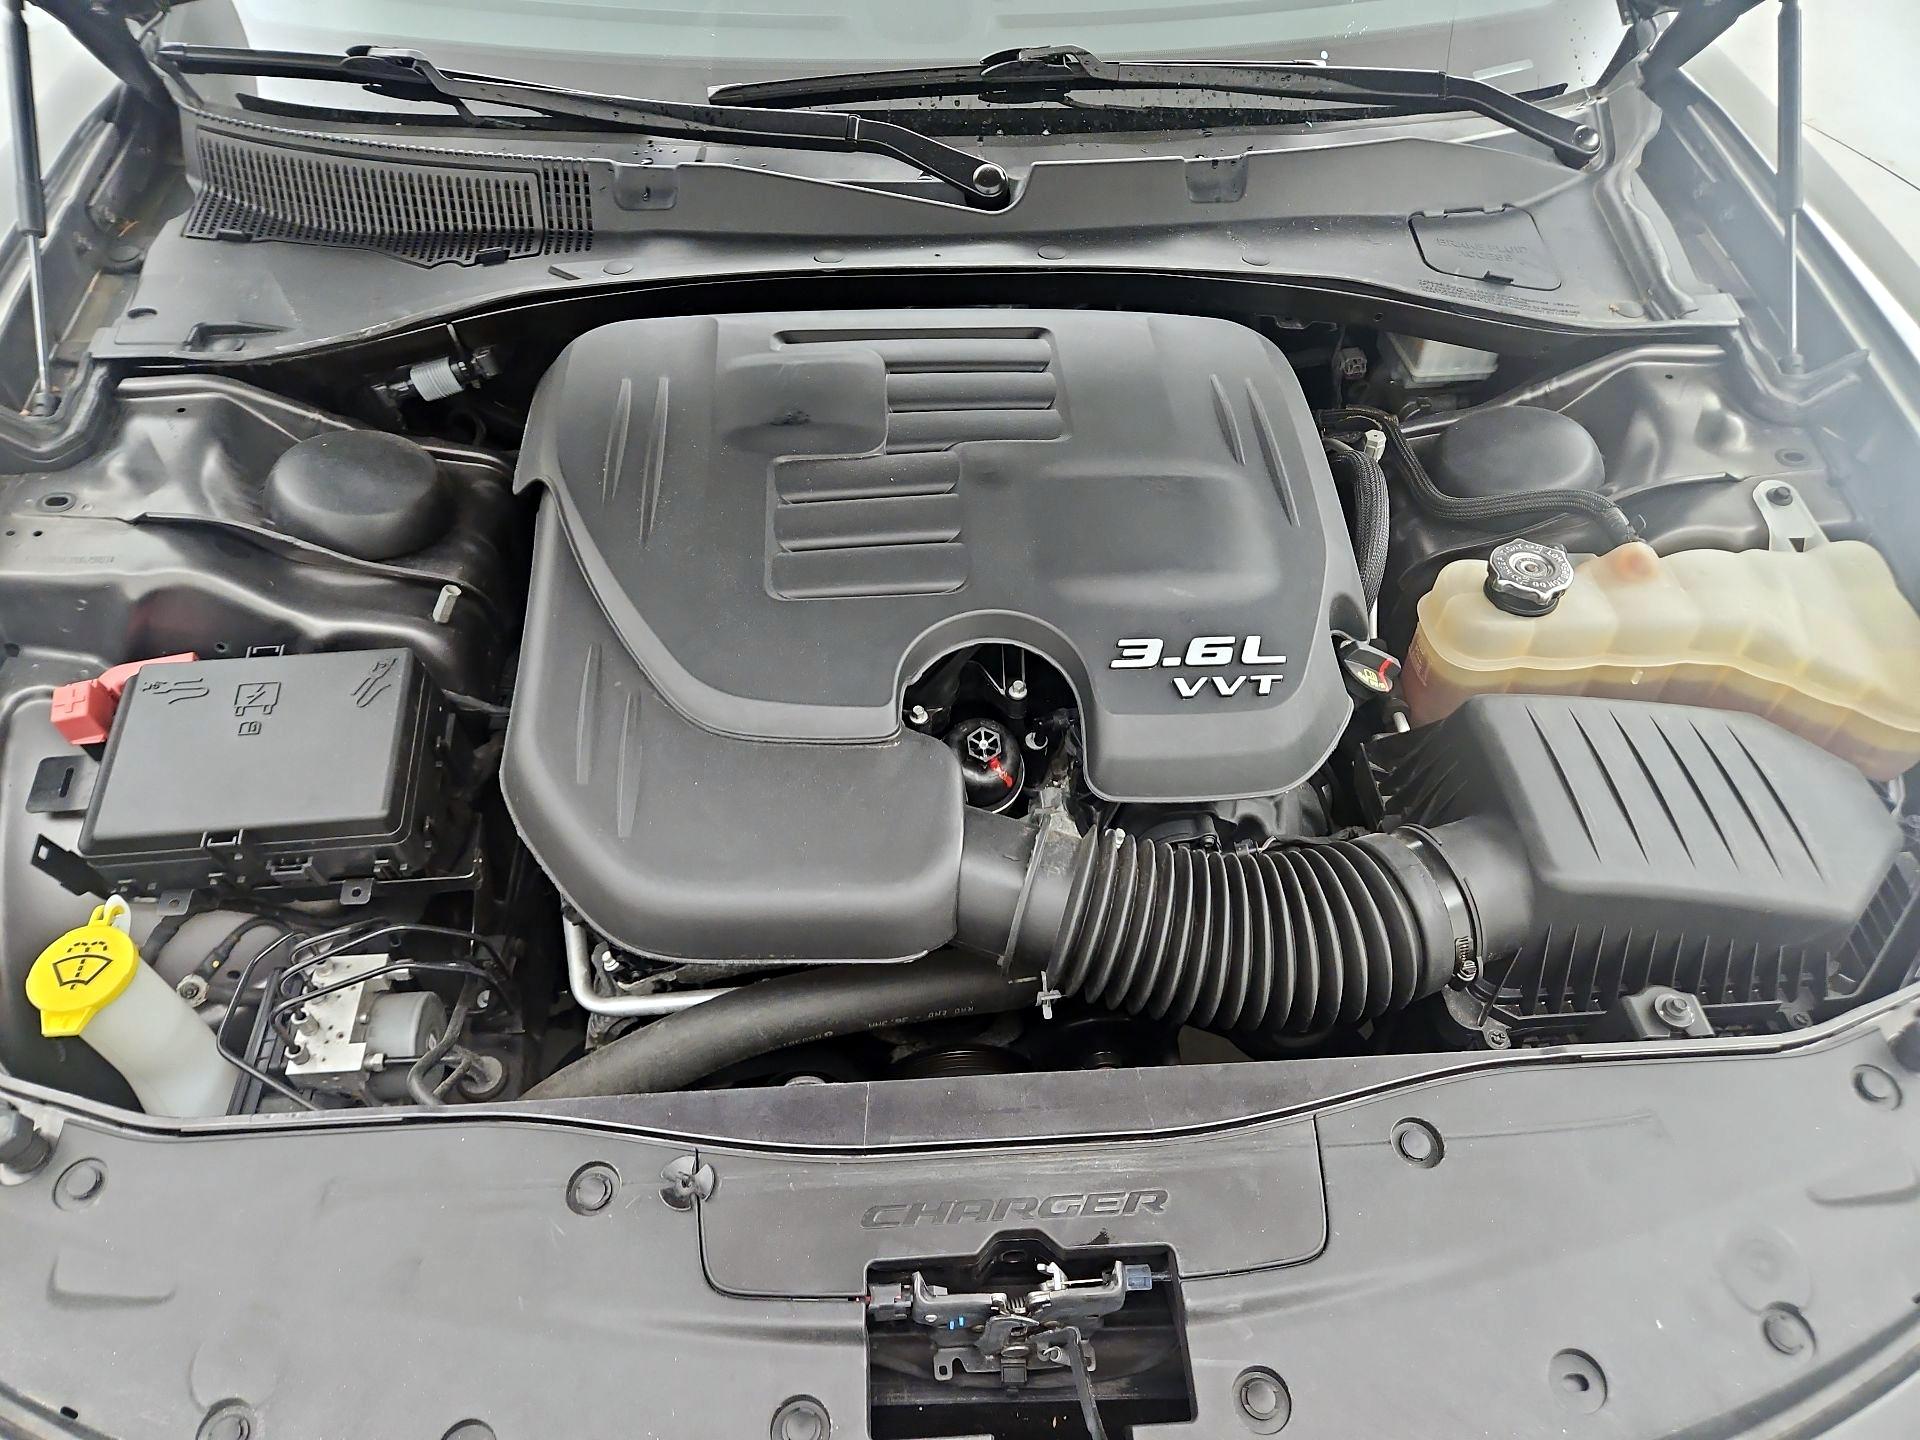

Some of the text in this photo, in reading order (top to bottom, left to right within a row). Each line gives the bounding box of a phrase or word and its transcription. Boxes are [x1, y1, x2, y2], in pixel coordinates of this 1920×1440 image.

[1110, 635, 1287, 669] 3.6L
[1171, 674, 1284, 699] VVT
[860, 1189, 1169, 1229] CHARGER
